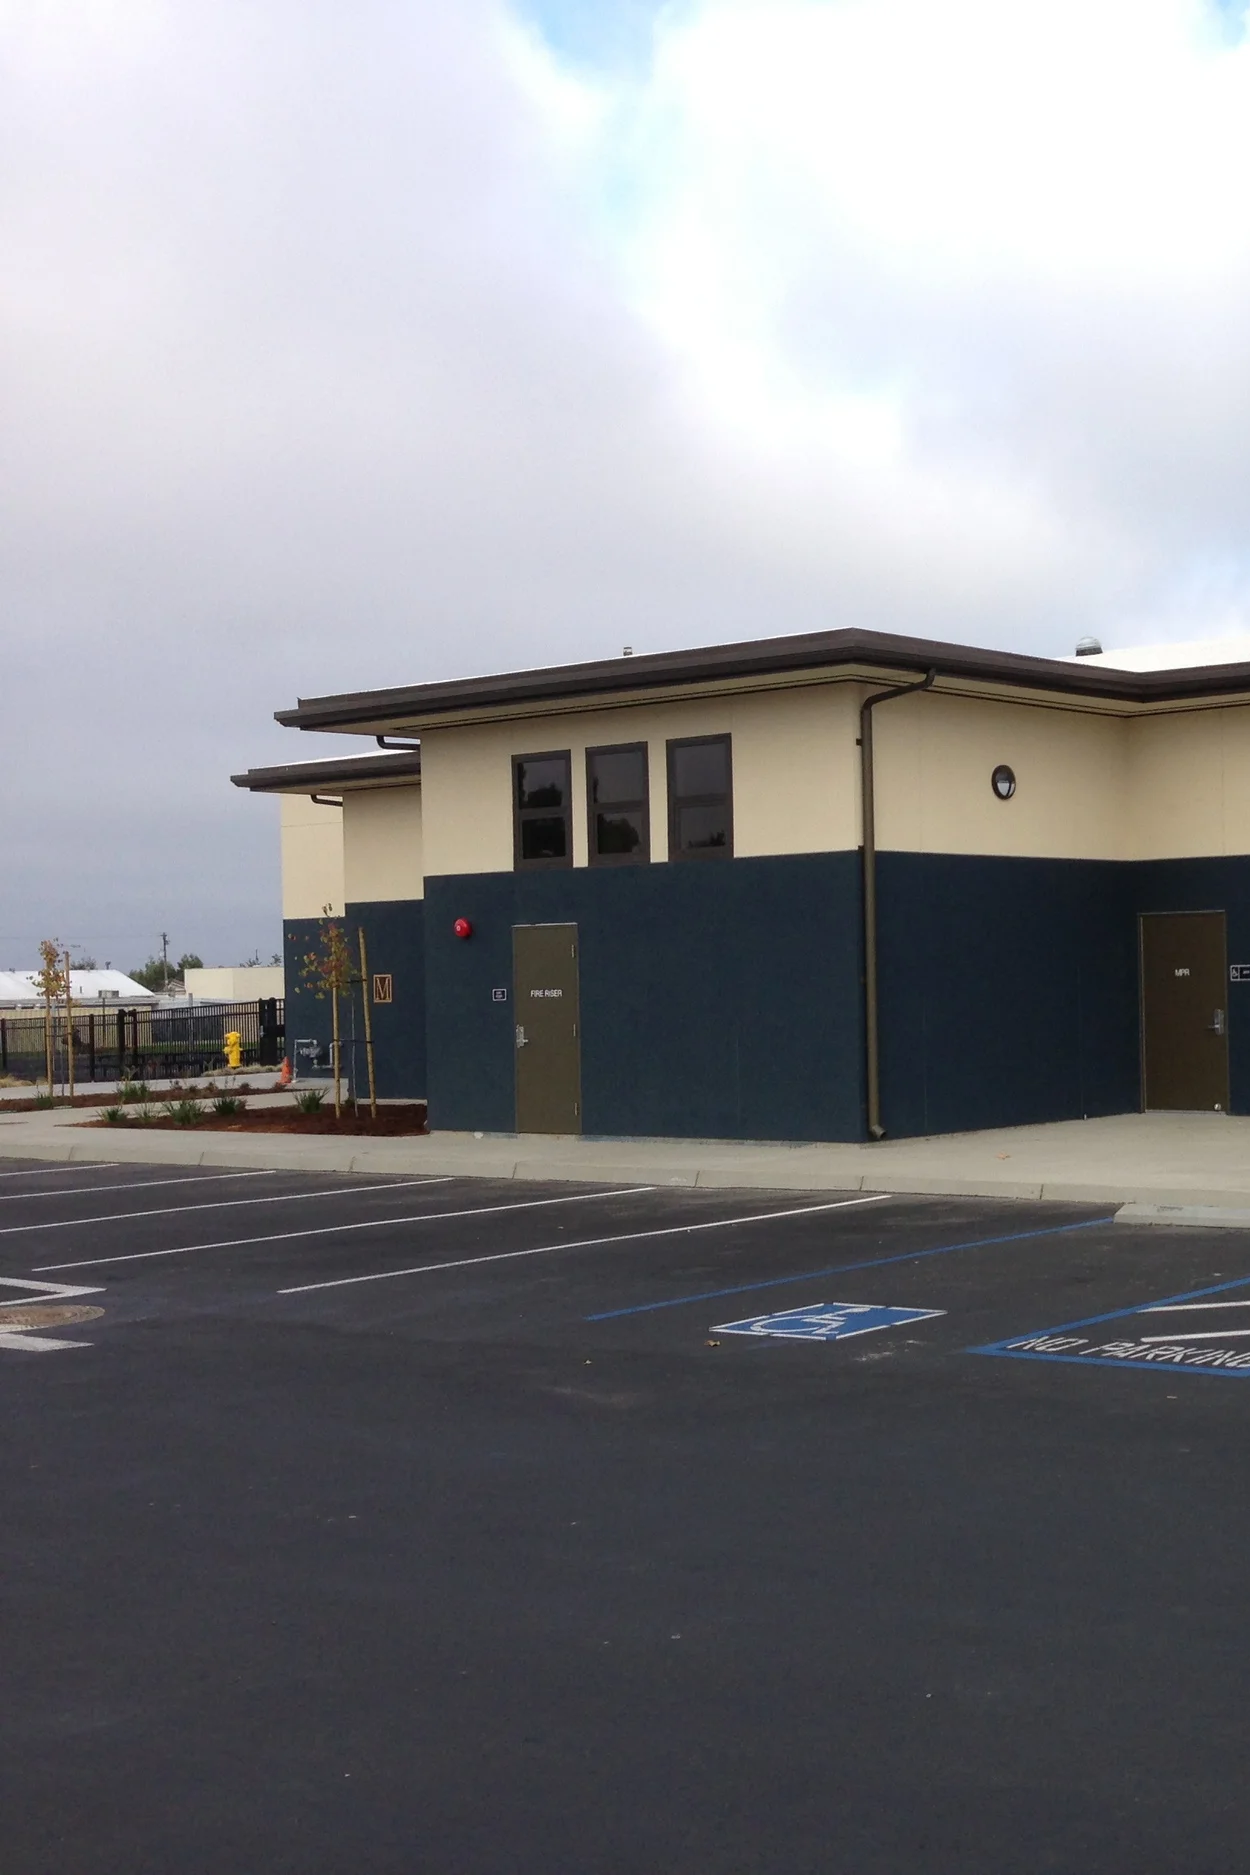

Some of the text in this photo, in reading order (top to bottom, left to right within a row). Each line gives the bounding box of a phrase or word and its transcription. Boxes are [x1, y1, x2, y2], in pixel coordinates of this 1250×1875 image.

[1175, 968, 1190, 977] MPR
[376, 977, 390, 1001] M
[1006, 1335, 1089, 1352] NO
